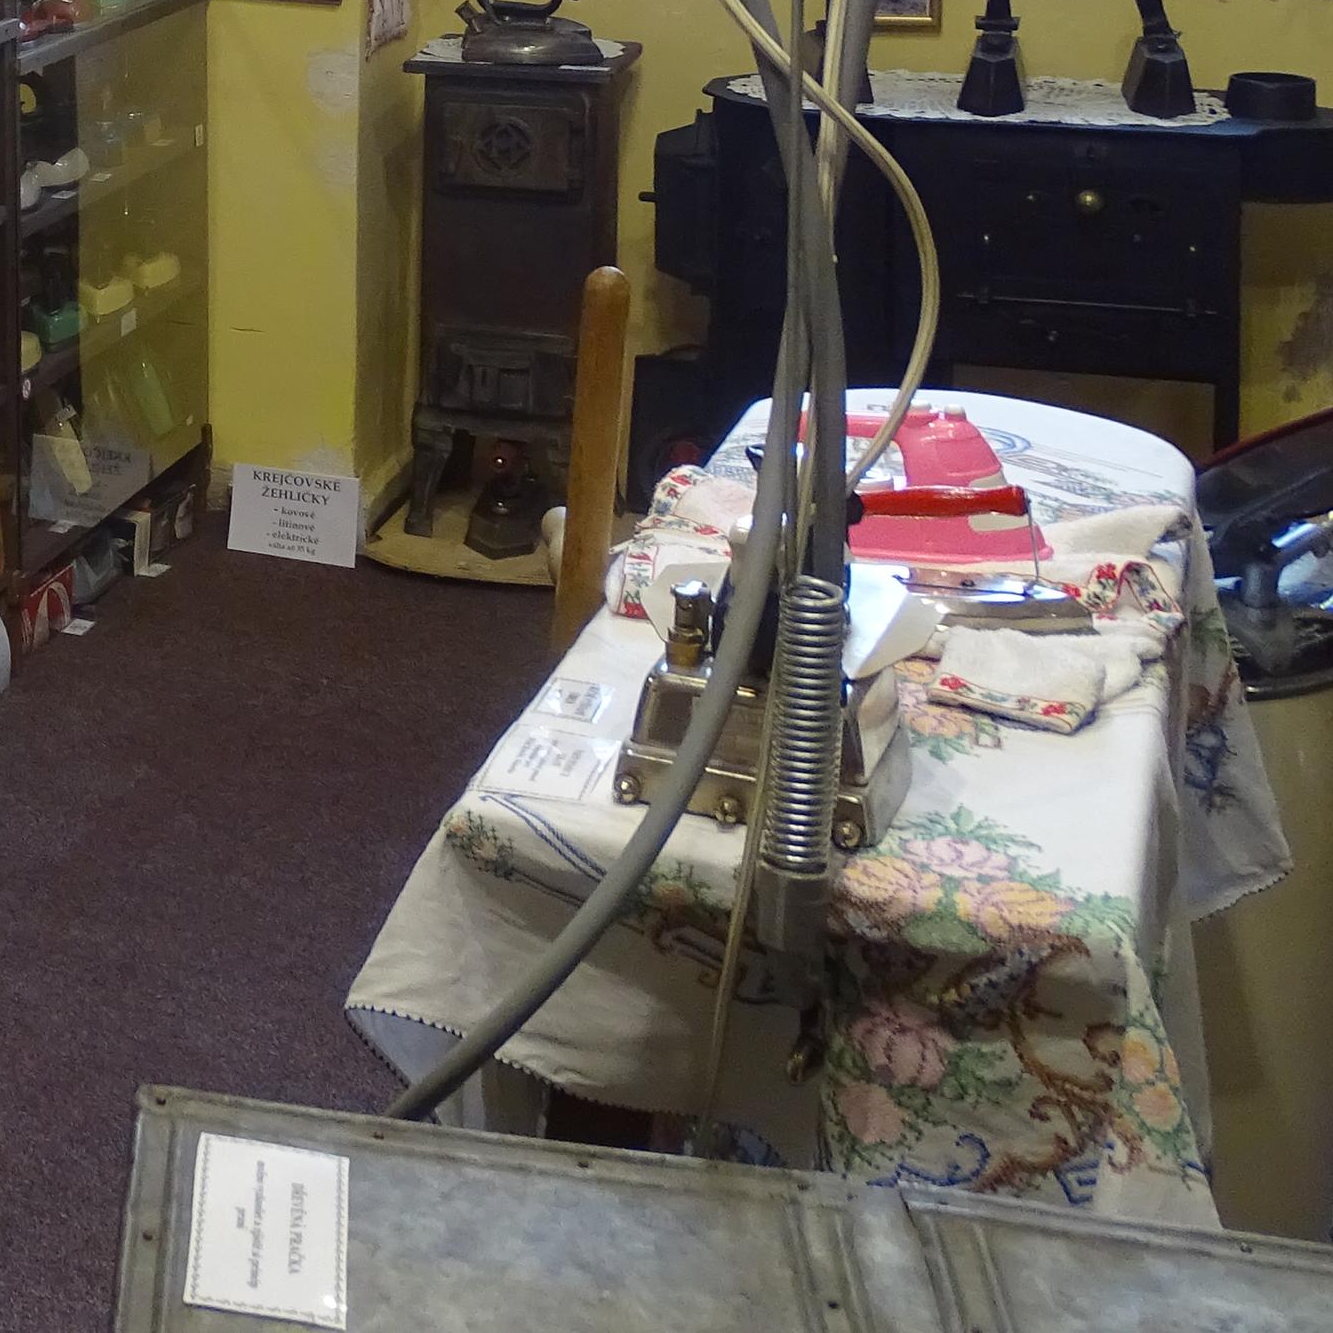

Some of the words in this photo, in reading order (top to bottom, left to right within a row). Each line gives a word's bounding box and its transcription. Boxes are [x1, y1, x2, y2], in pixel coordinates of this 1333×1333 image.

[252, 470, 341, 492] KREJČOVSKÉ
[261, 485, 330, 506] ŽEHLIČKY
[271, 531, 320, 545] elektrické
[306, 546, 316, 556] kg
